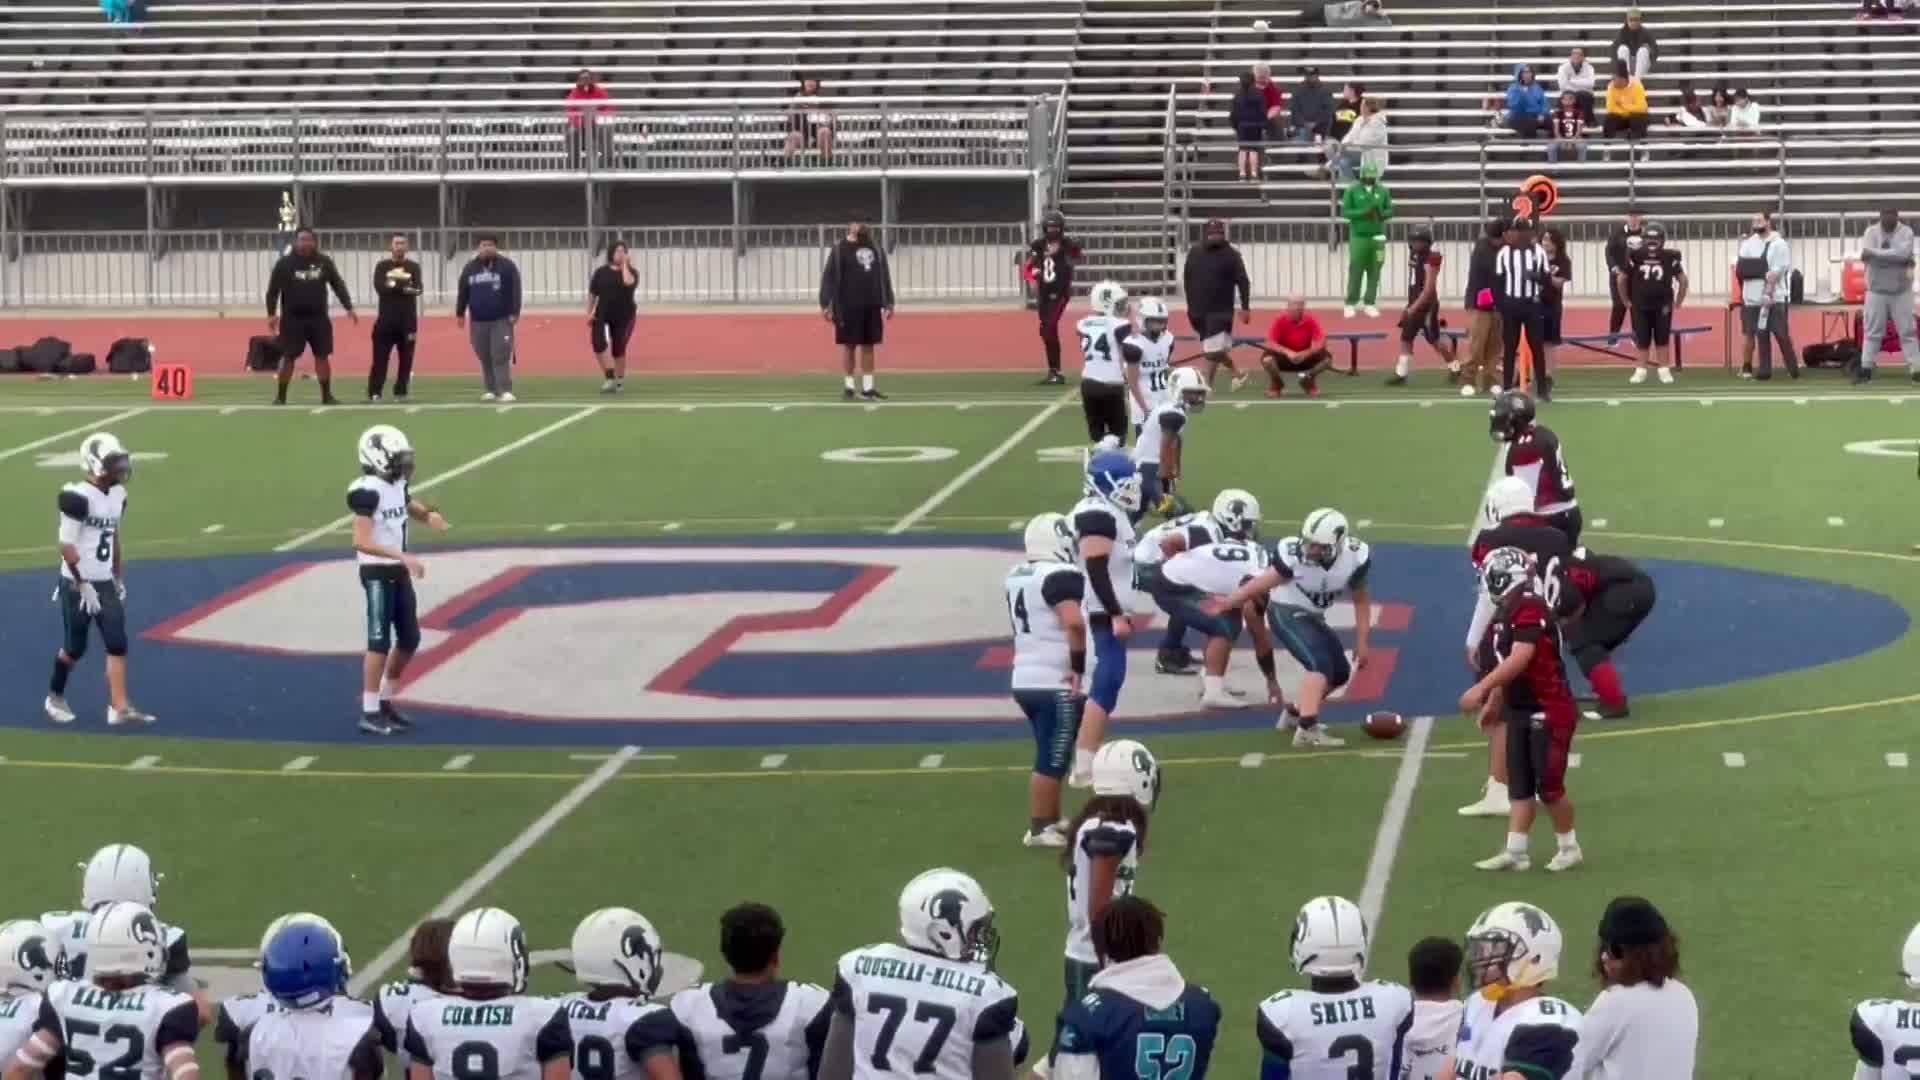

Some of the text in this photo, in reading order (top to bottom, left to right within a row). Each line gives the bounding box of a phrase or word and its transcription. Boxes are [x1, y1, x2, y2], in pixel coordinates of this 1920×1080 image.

[157, 368, 186, 396] 40
[854, 955, 986, 997] COUGHRAN-MILLER
[441, 1005, 515, 1026] CORNISH
[1310, 996, 1376, 1025] SMITH
[65, 1017, 145, 1080] 52
[867, 992, 957, 1075] 77
[1135, 1032, 1196, 1080] 52
